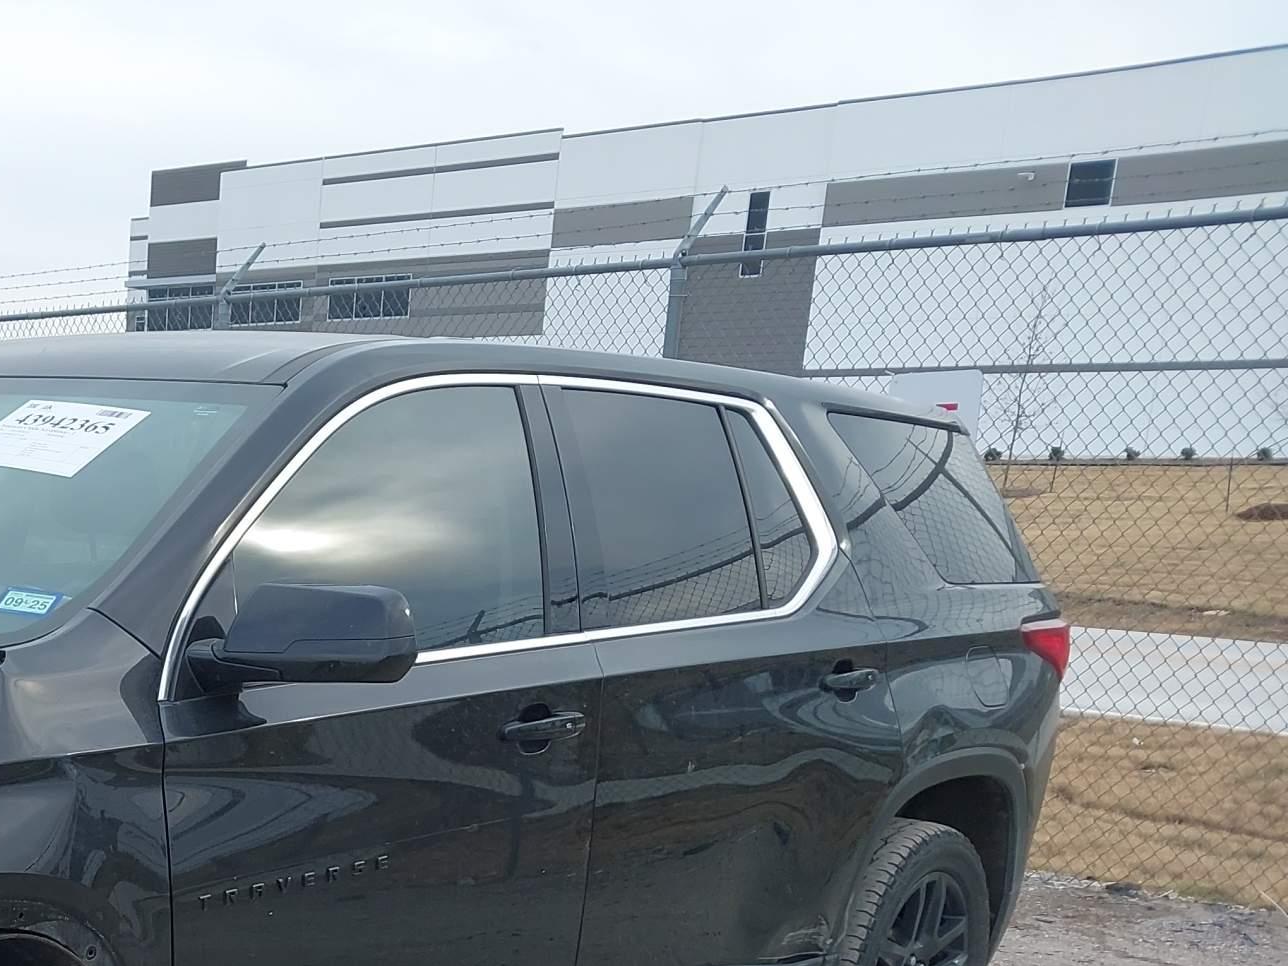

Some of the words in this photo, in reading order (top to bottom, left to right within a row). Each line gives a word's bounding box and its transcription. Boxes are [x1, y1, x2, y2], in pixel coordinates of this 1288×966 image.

[15, 413, 116, 435] 43942365
[4, 596, 24, 608] 09
[27, 599, 50, 611] 25
[197, 854, 391, 912] TRAVERSE
